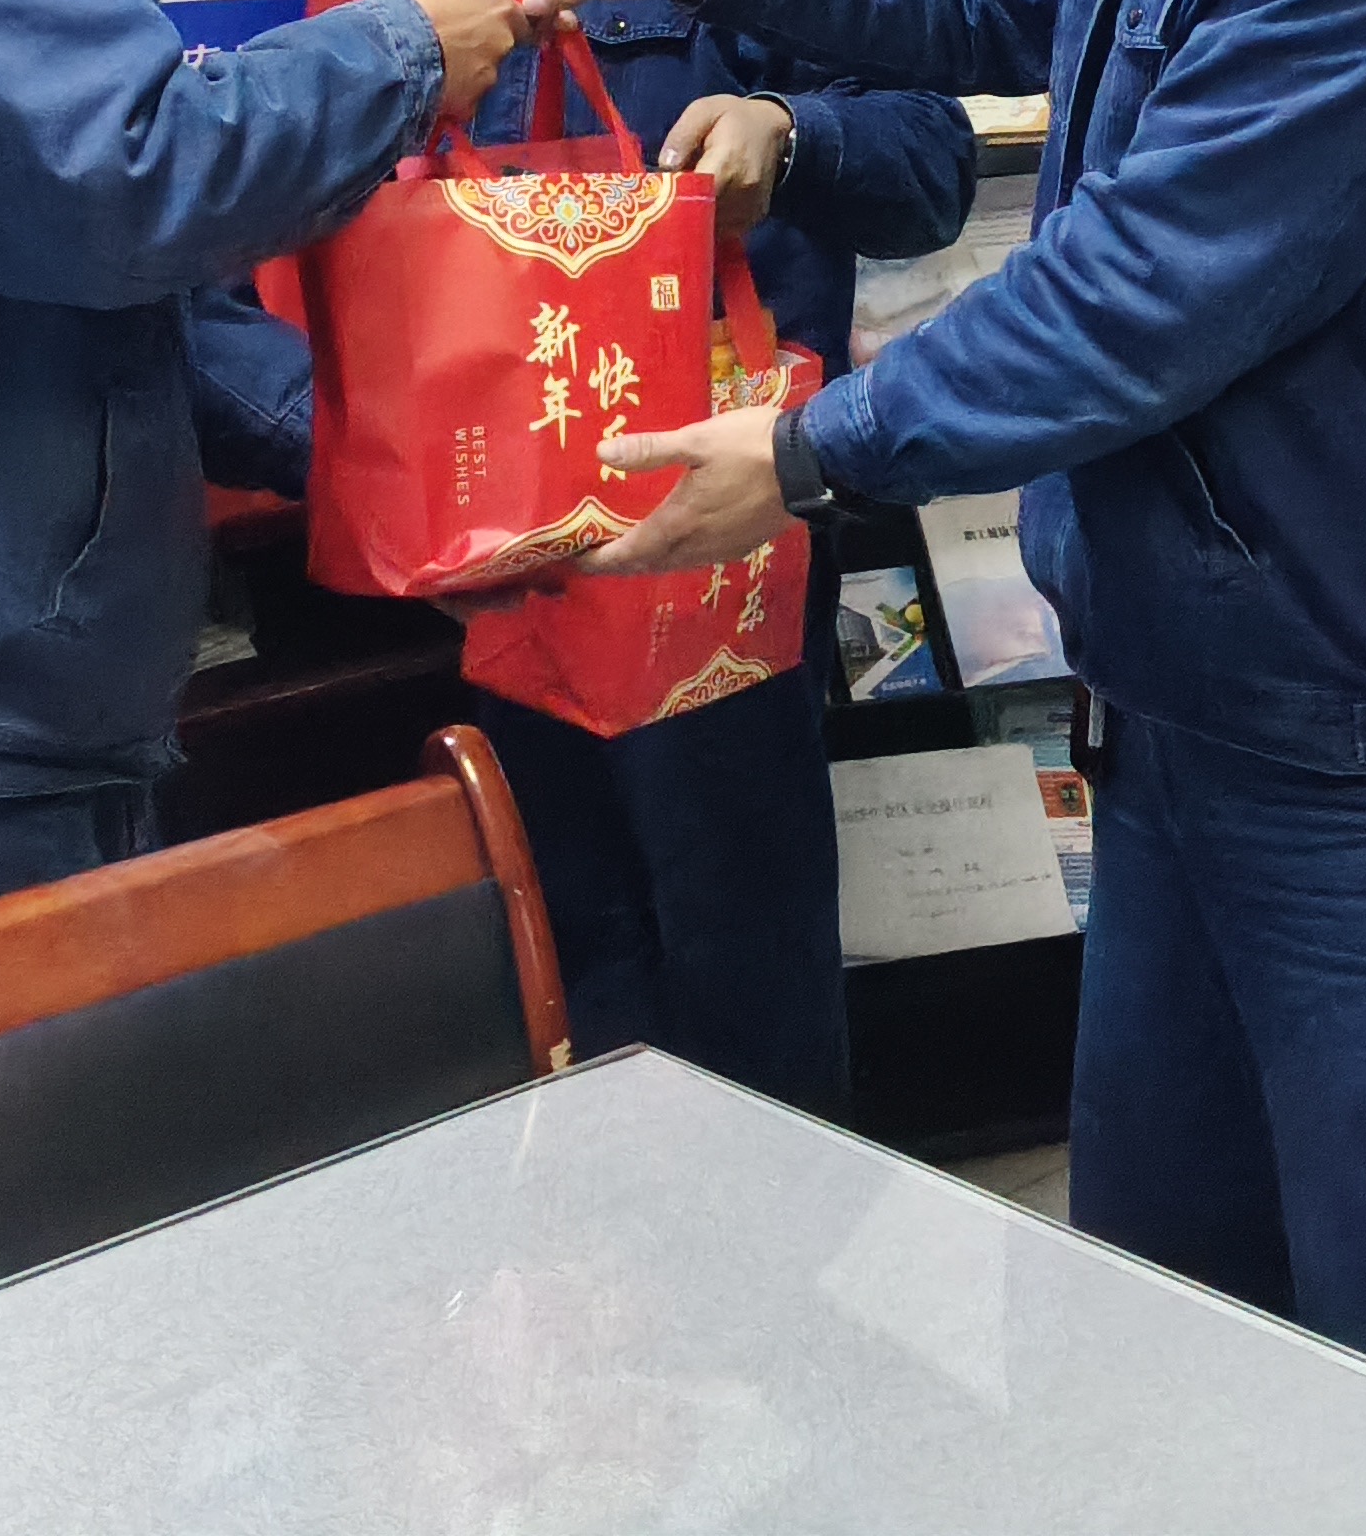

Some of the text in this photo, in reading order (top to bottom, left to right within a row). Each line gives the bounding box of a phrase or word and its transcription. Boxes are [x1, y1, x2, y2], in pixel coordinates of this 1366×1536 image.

[526, 301, 583, 450] 新年
[454, 427, 470, 506] WISHES
[472, 425, 487, 478] BEST
